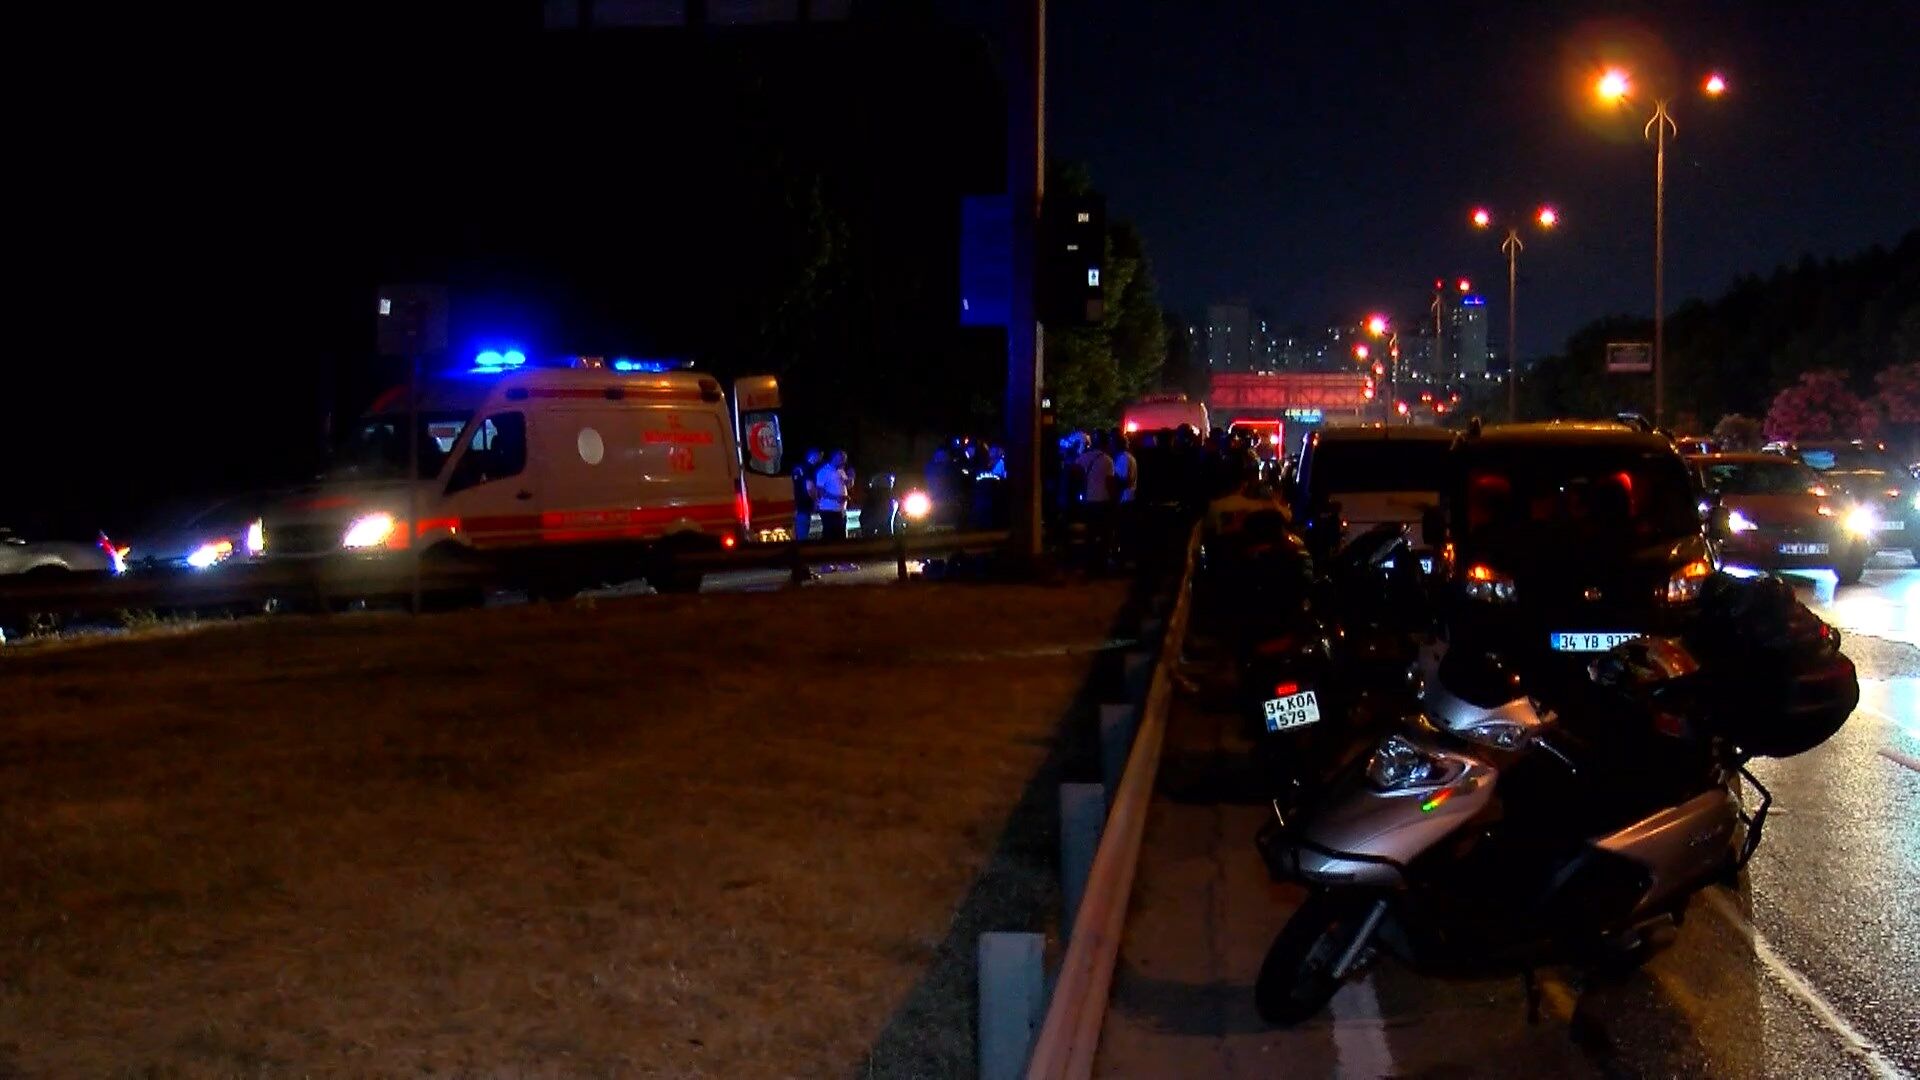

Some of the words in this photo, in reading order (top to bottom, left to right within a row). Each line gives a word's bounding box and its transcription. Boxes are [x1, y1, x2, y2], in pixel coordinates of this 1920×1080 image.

[1561, 635, 1576, 648] 34
[1584, 635, 1598, 648] YB
[1267, 701, 1284, 714] 34
[1287, 693, 1315, 709] KOA
[1279, 709, 1306, 726] 579
